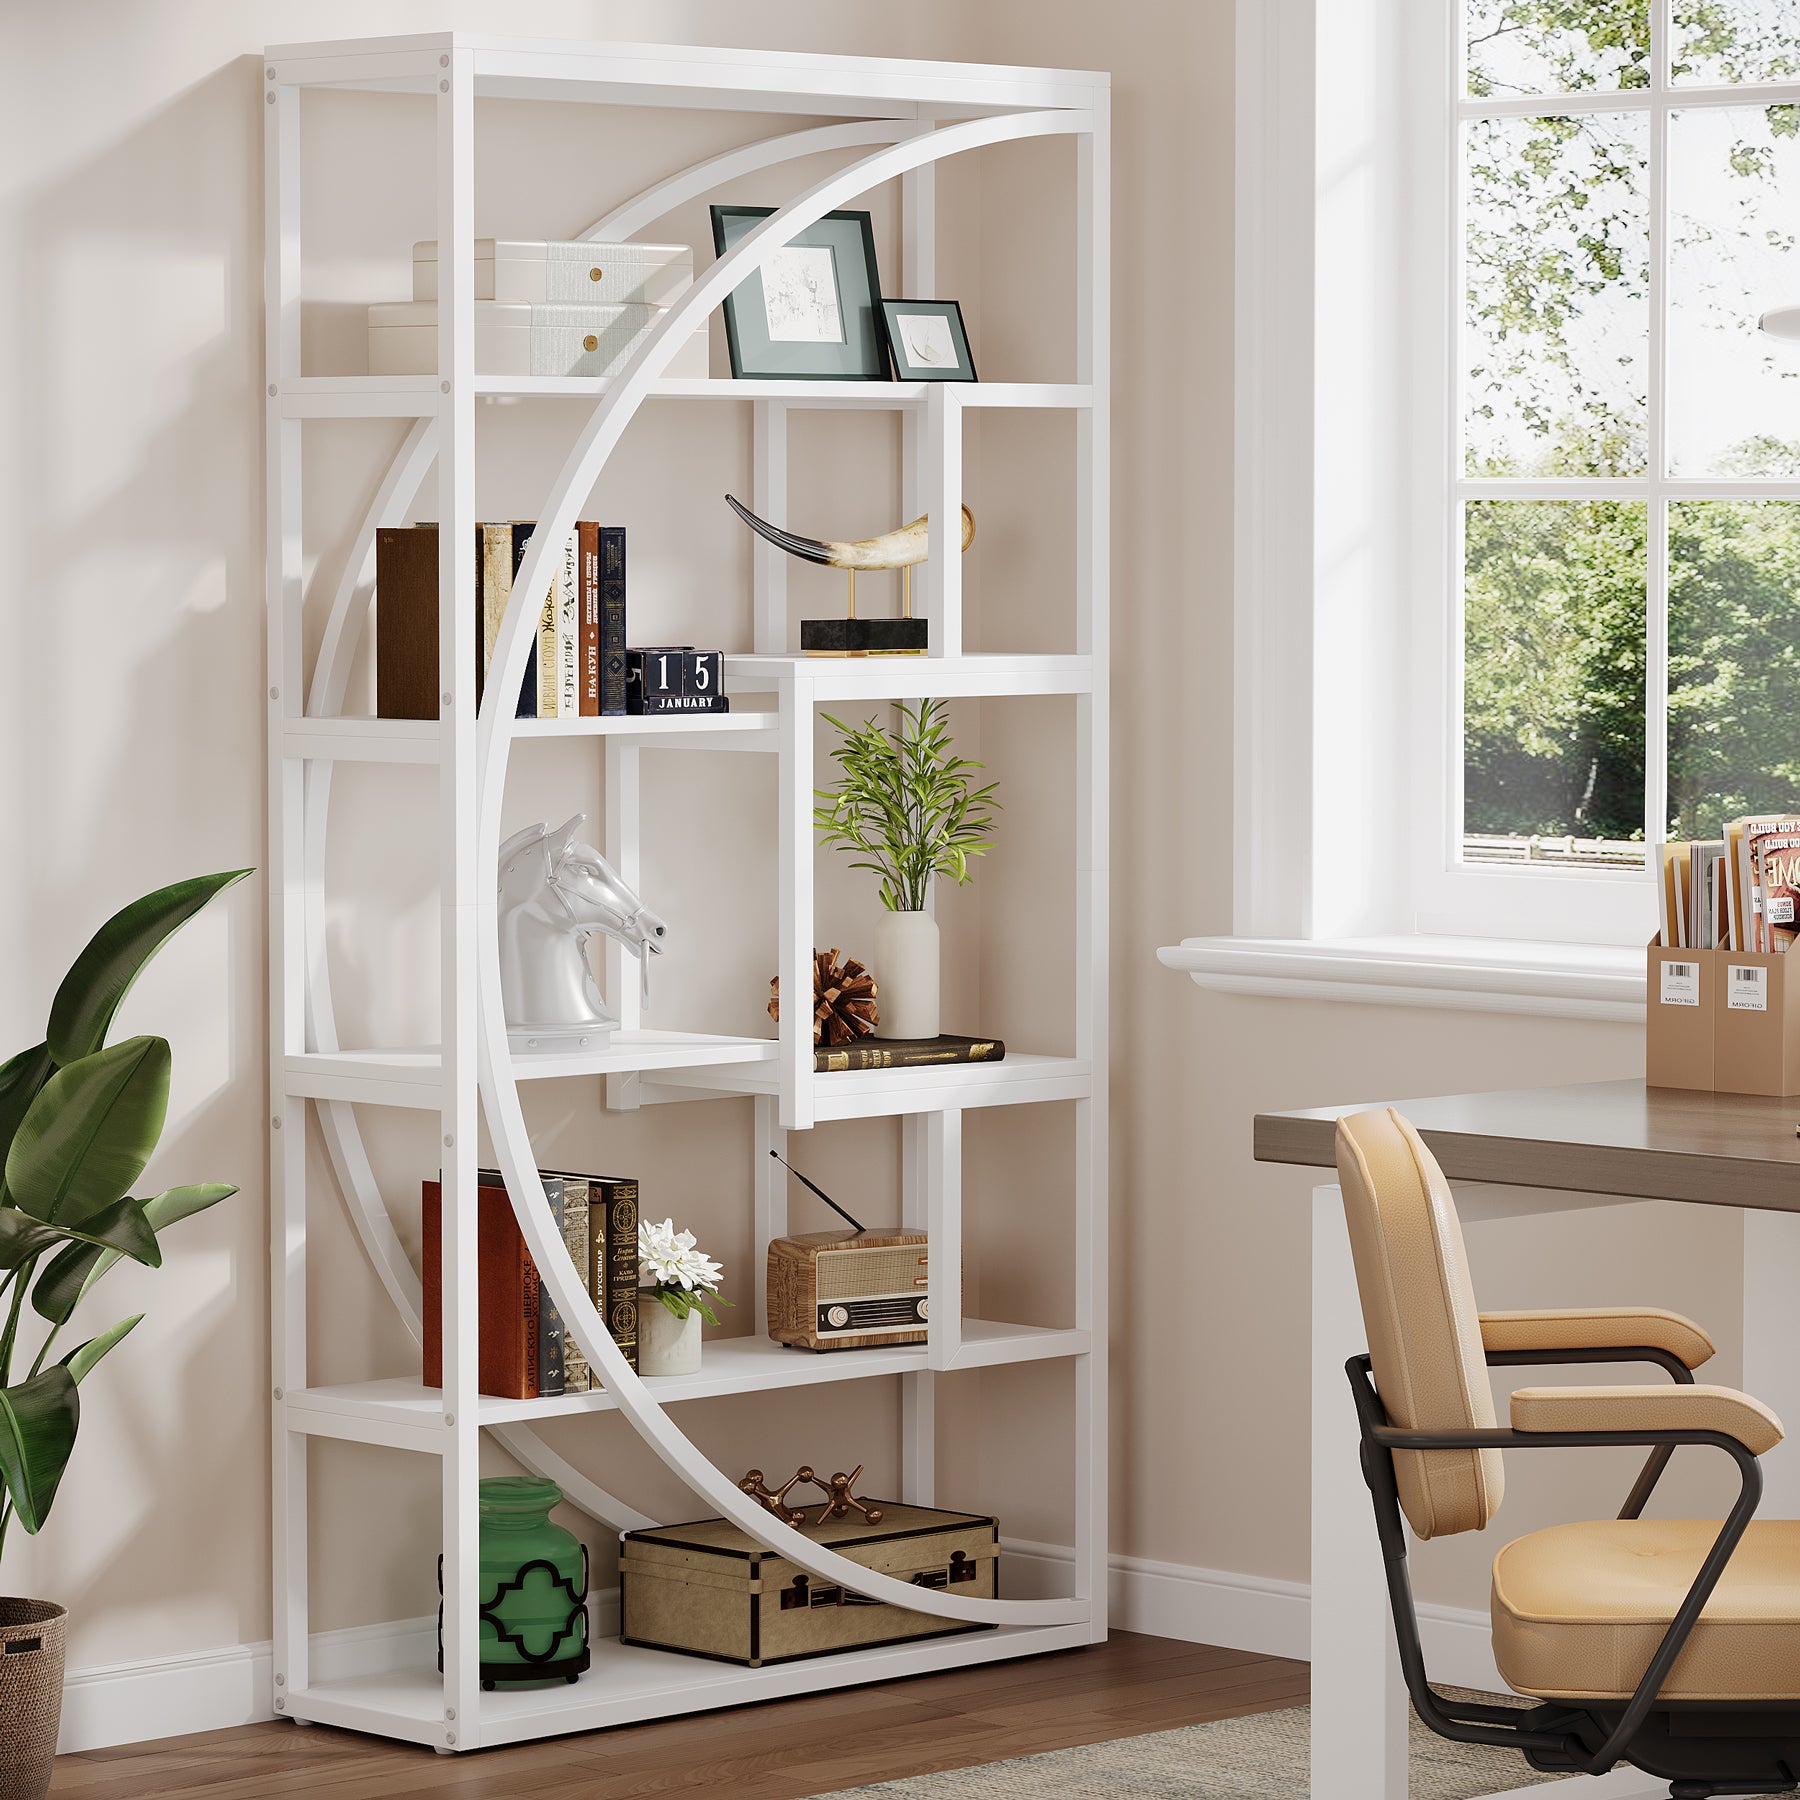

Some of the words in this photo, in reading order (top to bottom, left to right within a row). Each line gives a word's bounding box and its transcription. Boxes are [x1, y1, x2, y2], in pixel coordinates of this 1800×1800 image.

[543, 636, 555, 669] СТОУН
[658, 655, 669, 690] 1
[695, 655, 709, 690] 5
[543, 673, 555, 710] ИРВИНГ
[659, 697, 714, 708] JANUARY
[527, 1319, 535, 1330] О
[527, 1331, 536, 1391] ЗАПИСКИ
